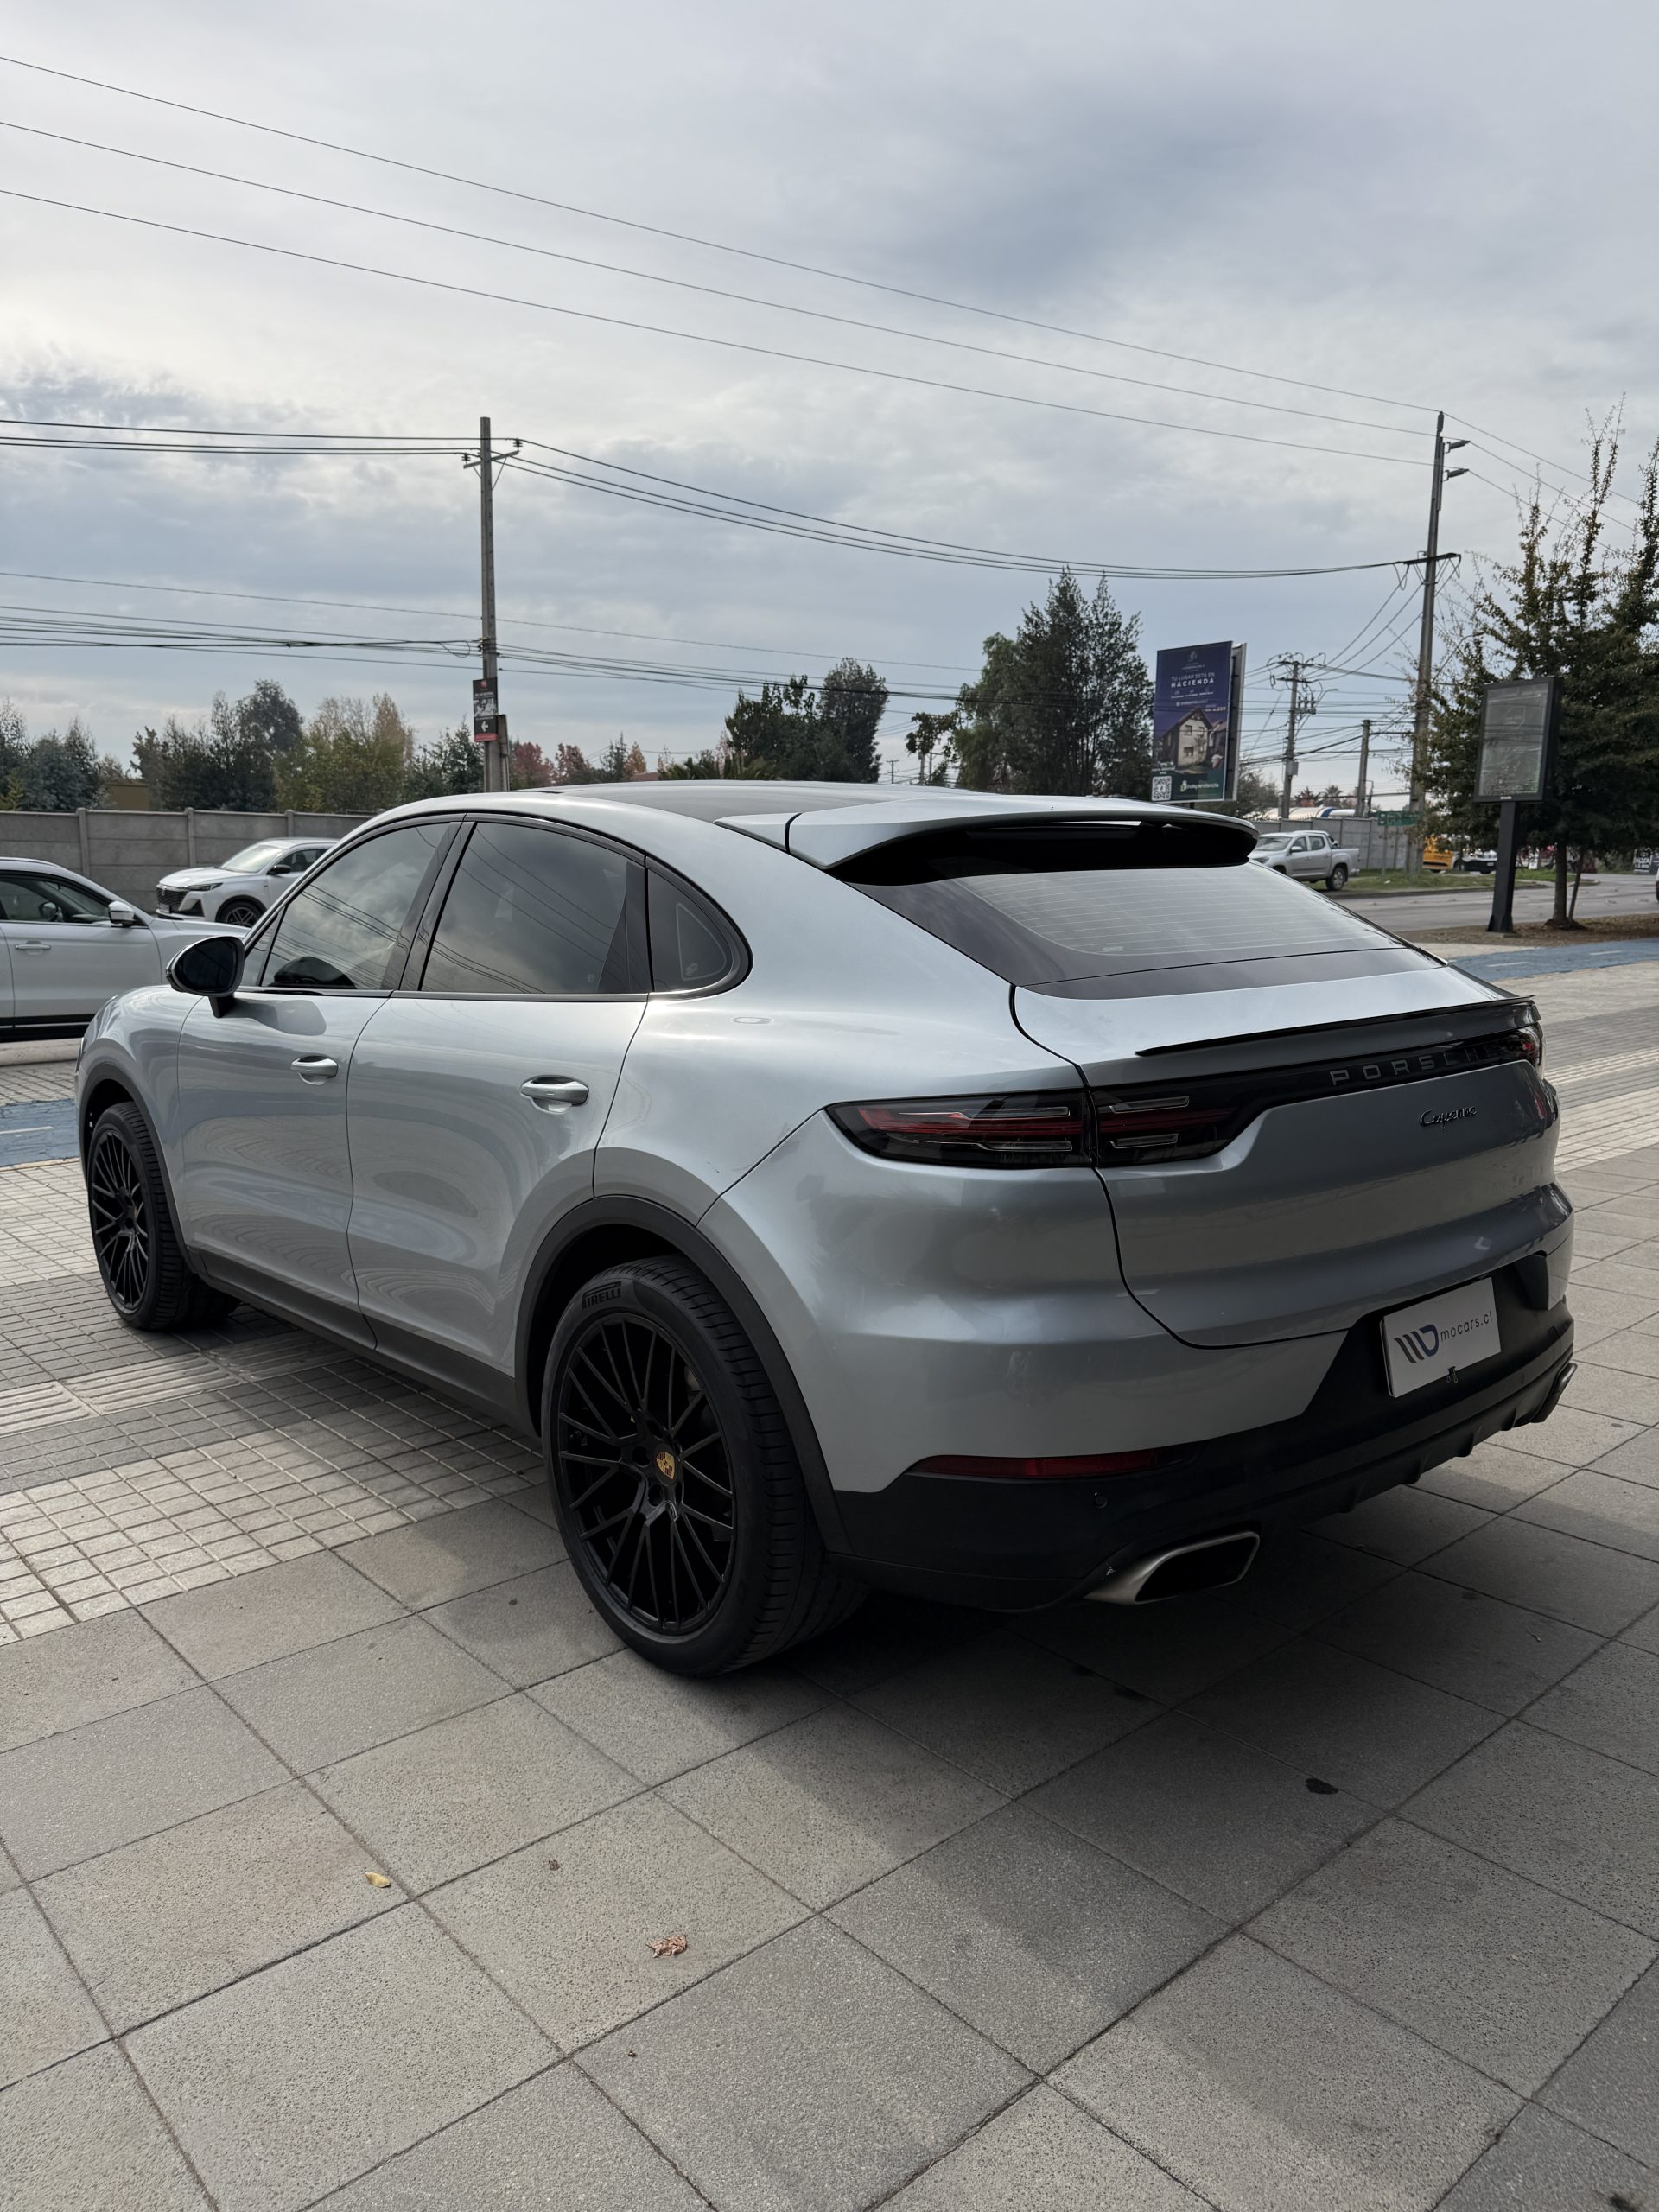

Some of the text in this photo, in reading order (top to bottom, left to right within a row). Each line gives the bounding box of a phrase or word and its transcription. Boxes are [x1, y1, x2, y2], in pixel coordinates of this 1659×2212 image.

[1171, 677, 1214, 688] HACIENDA
[1420, 1105, 1477, 1129] Cayenne
[582, 1281, 621, 1309] PIRELLI
[1440, 1310, 1492, 1342] mocars.cl
